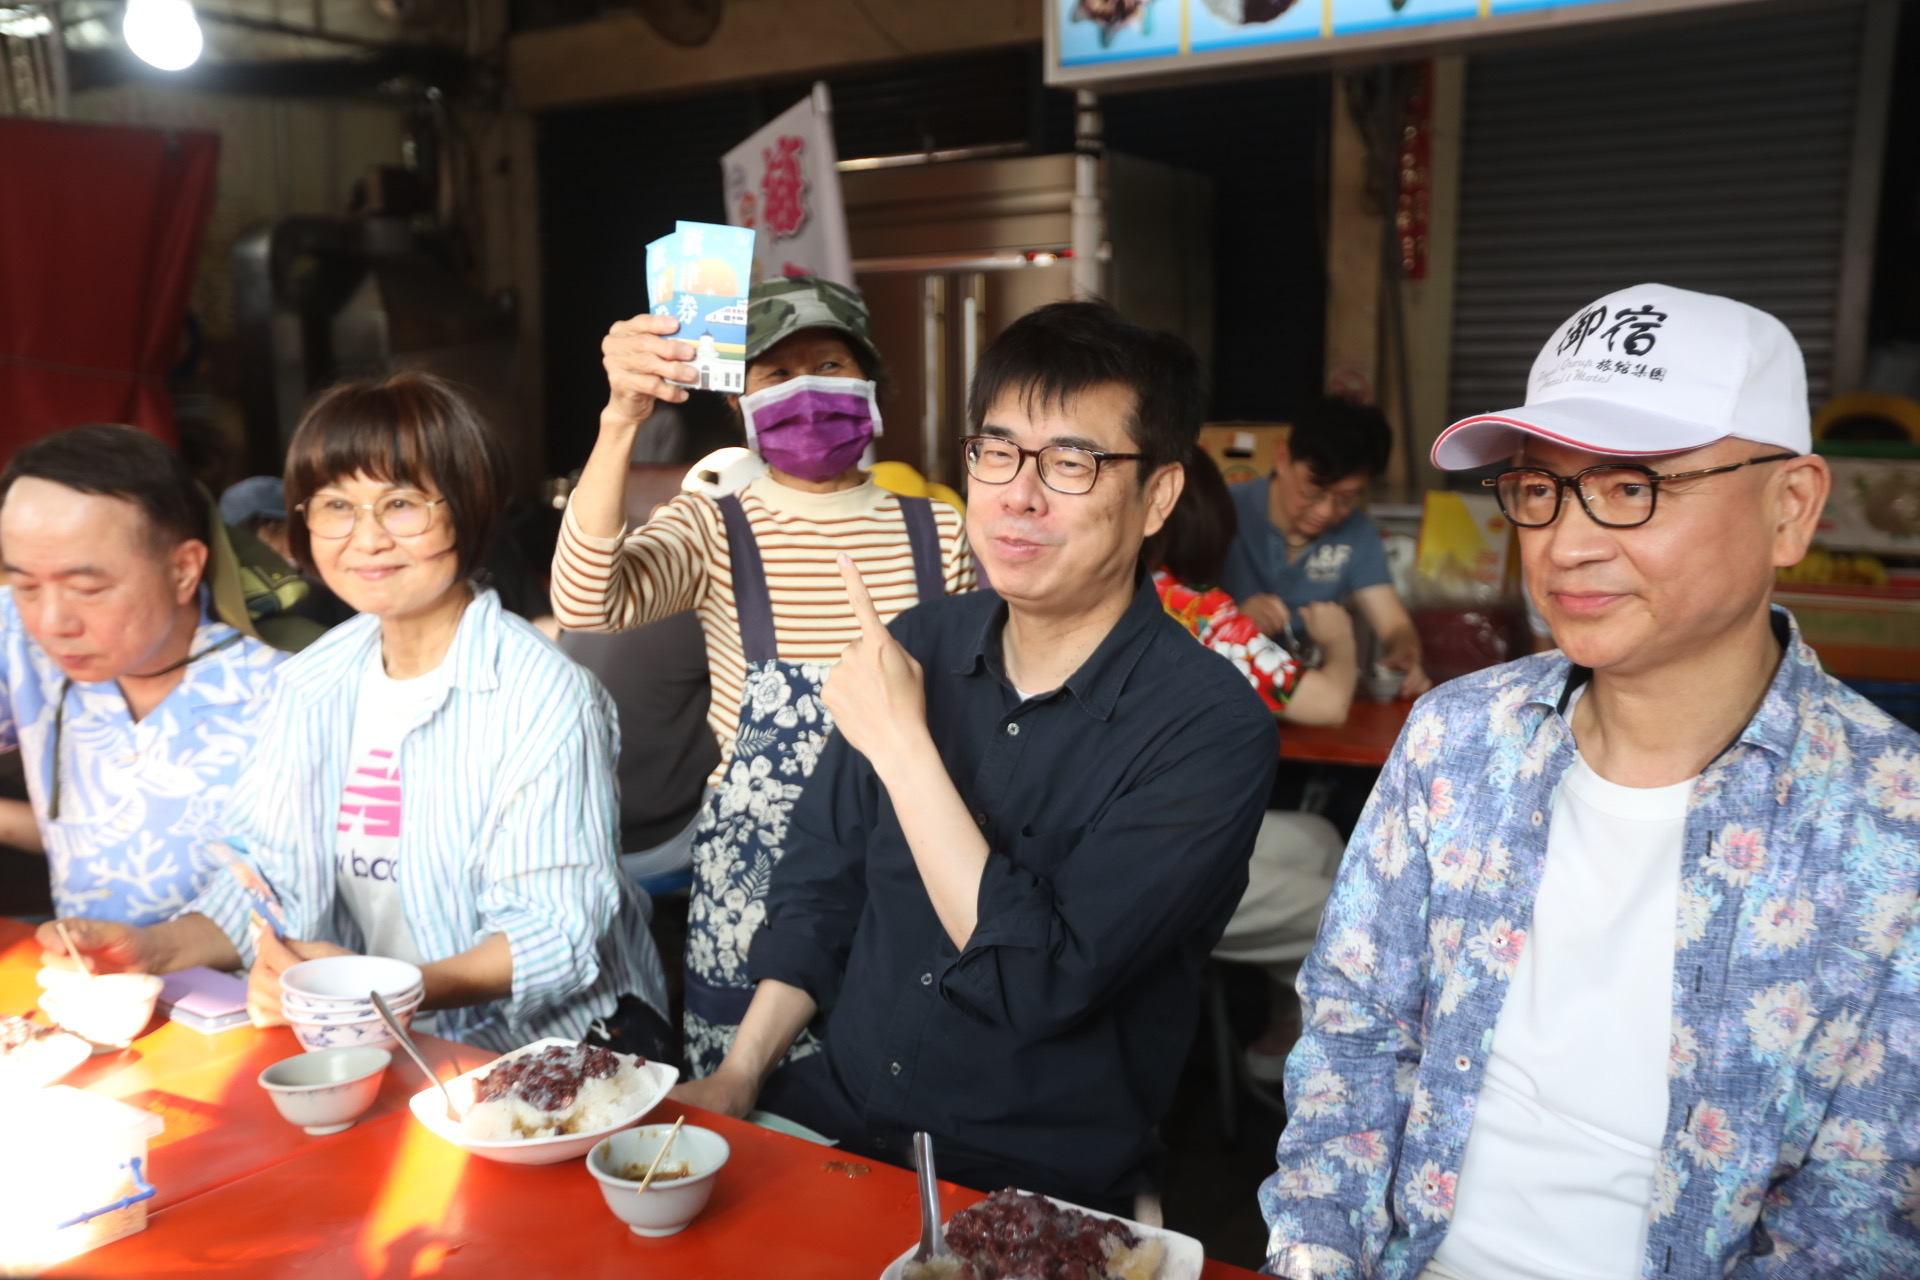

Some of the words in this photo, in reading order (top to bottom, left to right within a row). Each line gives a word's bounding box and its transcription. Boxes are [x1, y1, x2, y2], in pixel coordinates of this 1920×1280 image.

[1557, 304, 1668, 357] 御宿
[1573, 368, 1613, 383] Motel
[1596, 359, 1667, 382] 旅館集團
